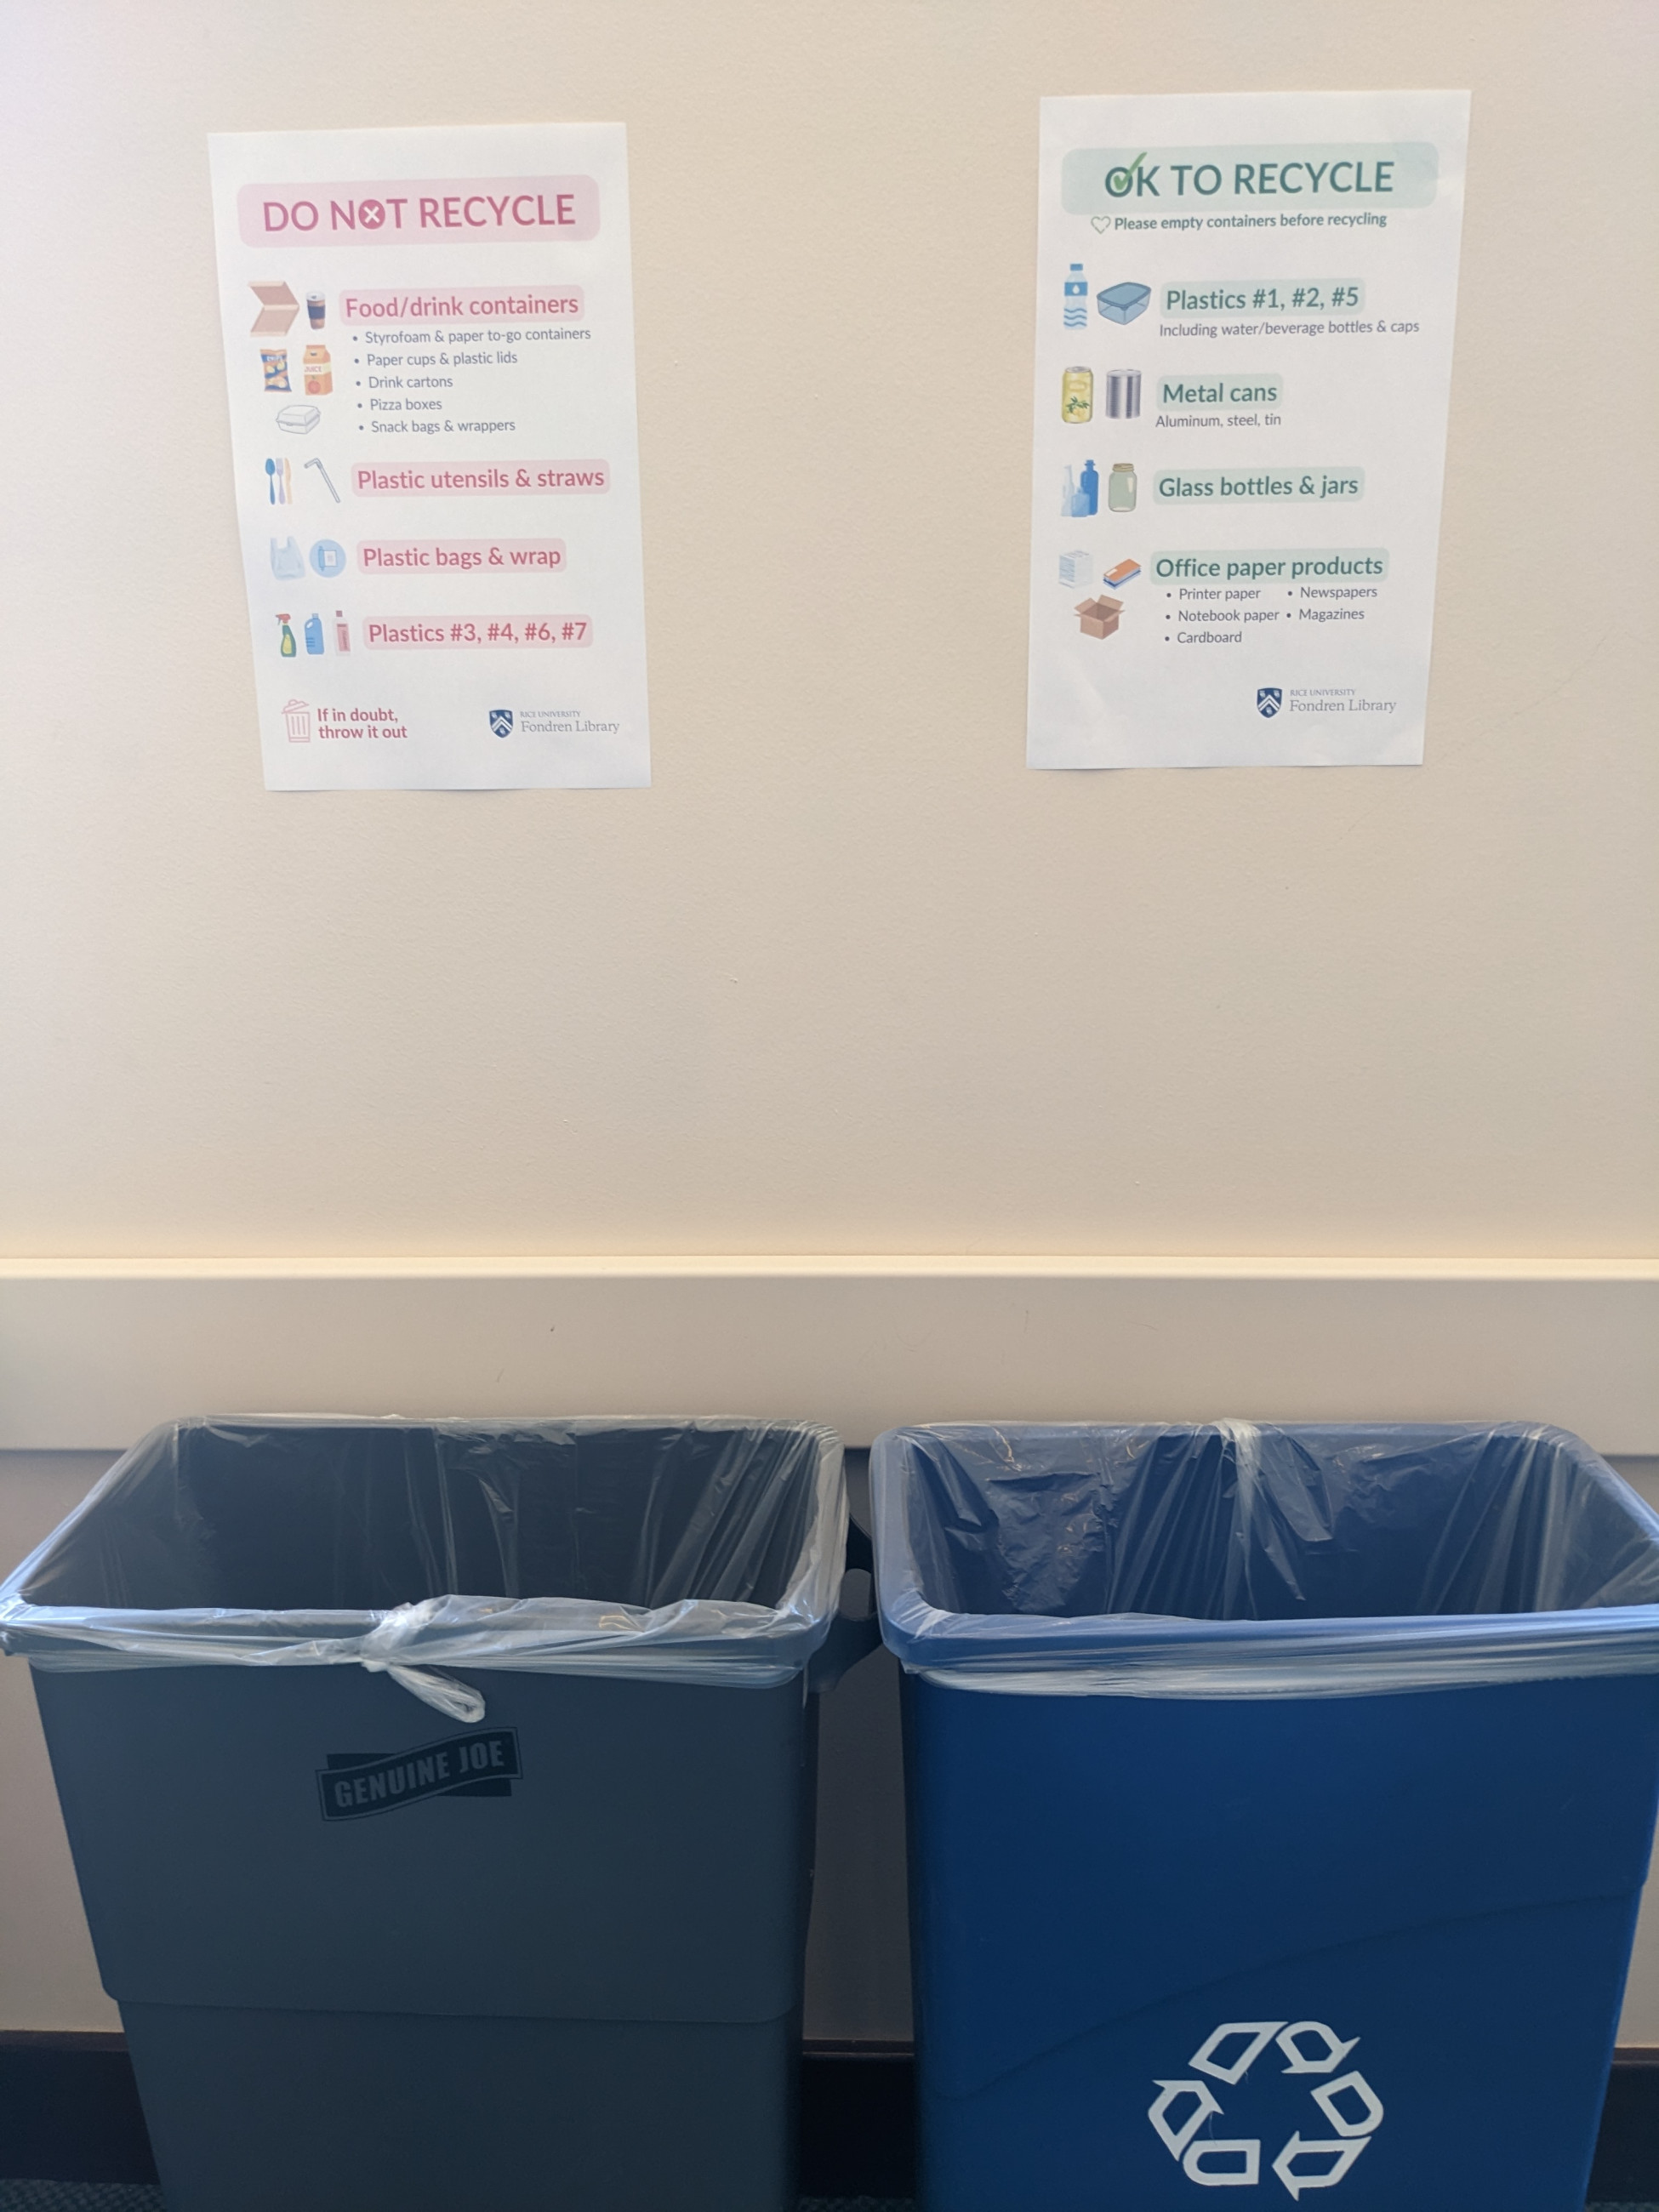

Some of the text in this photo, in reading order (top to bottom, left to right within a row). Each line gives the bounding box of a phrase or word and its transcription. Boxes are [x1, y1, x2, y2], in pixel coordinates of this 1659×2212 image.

[1104, 161, 1394, 198] OK TO RECYCLE
[263, 201, 319, 232] DO
[419, 193, 576, 228] RECYCLE
[1115, 211, 1388, 231] Please empty containers before recycling
[345, 294, 579, 318] Food/drink containers
[1166, 287, 1359, 311] Plastics #1, #2, #5
[365, 327, 591, 346] Styrofoam & paper to-go containers
[1160, 319, 1420, 339] Including water/beverage bottles & caps
[367, 351, 518, 368] Paper cups & plastic lids
[368, 376, 453, 389] Drink cartons
[1163, 382, 1277, 403] Metal cans
[370, 397, 442, 411] Pizza boxes
[371, 419, 516, 436] Snack bags & wrappers
[1154, 413, 1281, 428] Aluminum, steel, tin
[357, 468, 605, 489] Plastic utensils & straws
[1159, 475, 1359, 499] Glass bottles & jars
[363, 546, 562, 570] Plastic bags & wrap
[1155, 556, 1383, 581] Office paper products
[1179, 588, 1262, 602] Printer paper
[1300, 586, 1378, 601] Newspapers
[1178, 608, 1280, 624] Notebook paper
[1298, 607, 1365, 623] Magazines
[368, 623, 445, 643] Plastics
[450, 623, 482, 644] #3,
[487, 623, 519, 644] #4,
[524, 622, 556, 643] #6,
[562, 622, 587, 641] #7
[1177, 630, 1242, 644] Cardboard
[317, 707, 398, 723] If in doubt,
[1290, 699, 1396, 714] Fondren Library
[318, 724, 408, 739] throw it out
[522, 721, 619, 734] Fondren Library
[335, 1741, 504, 1807] GENUINE JOE
